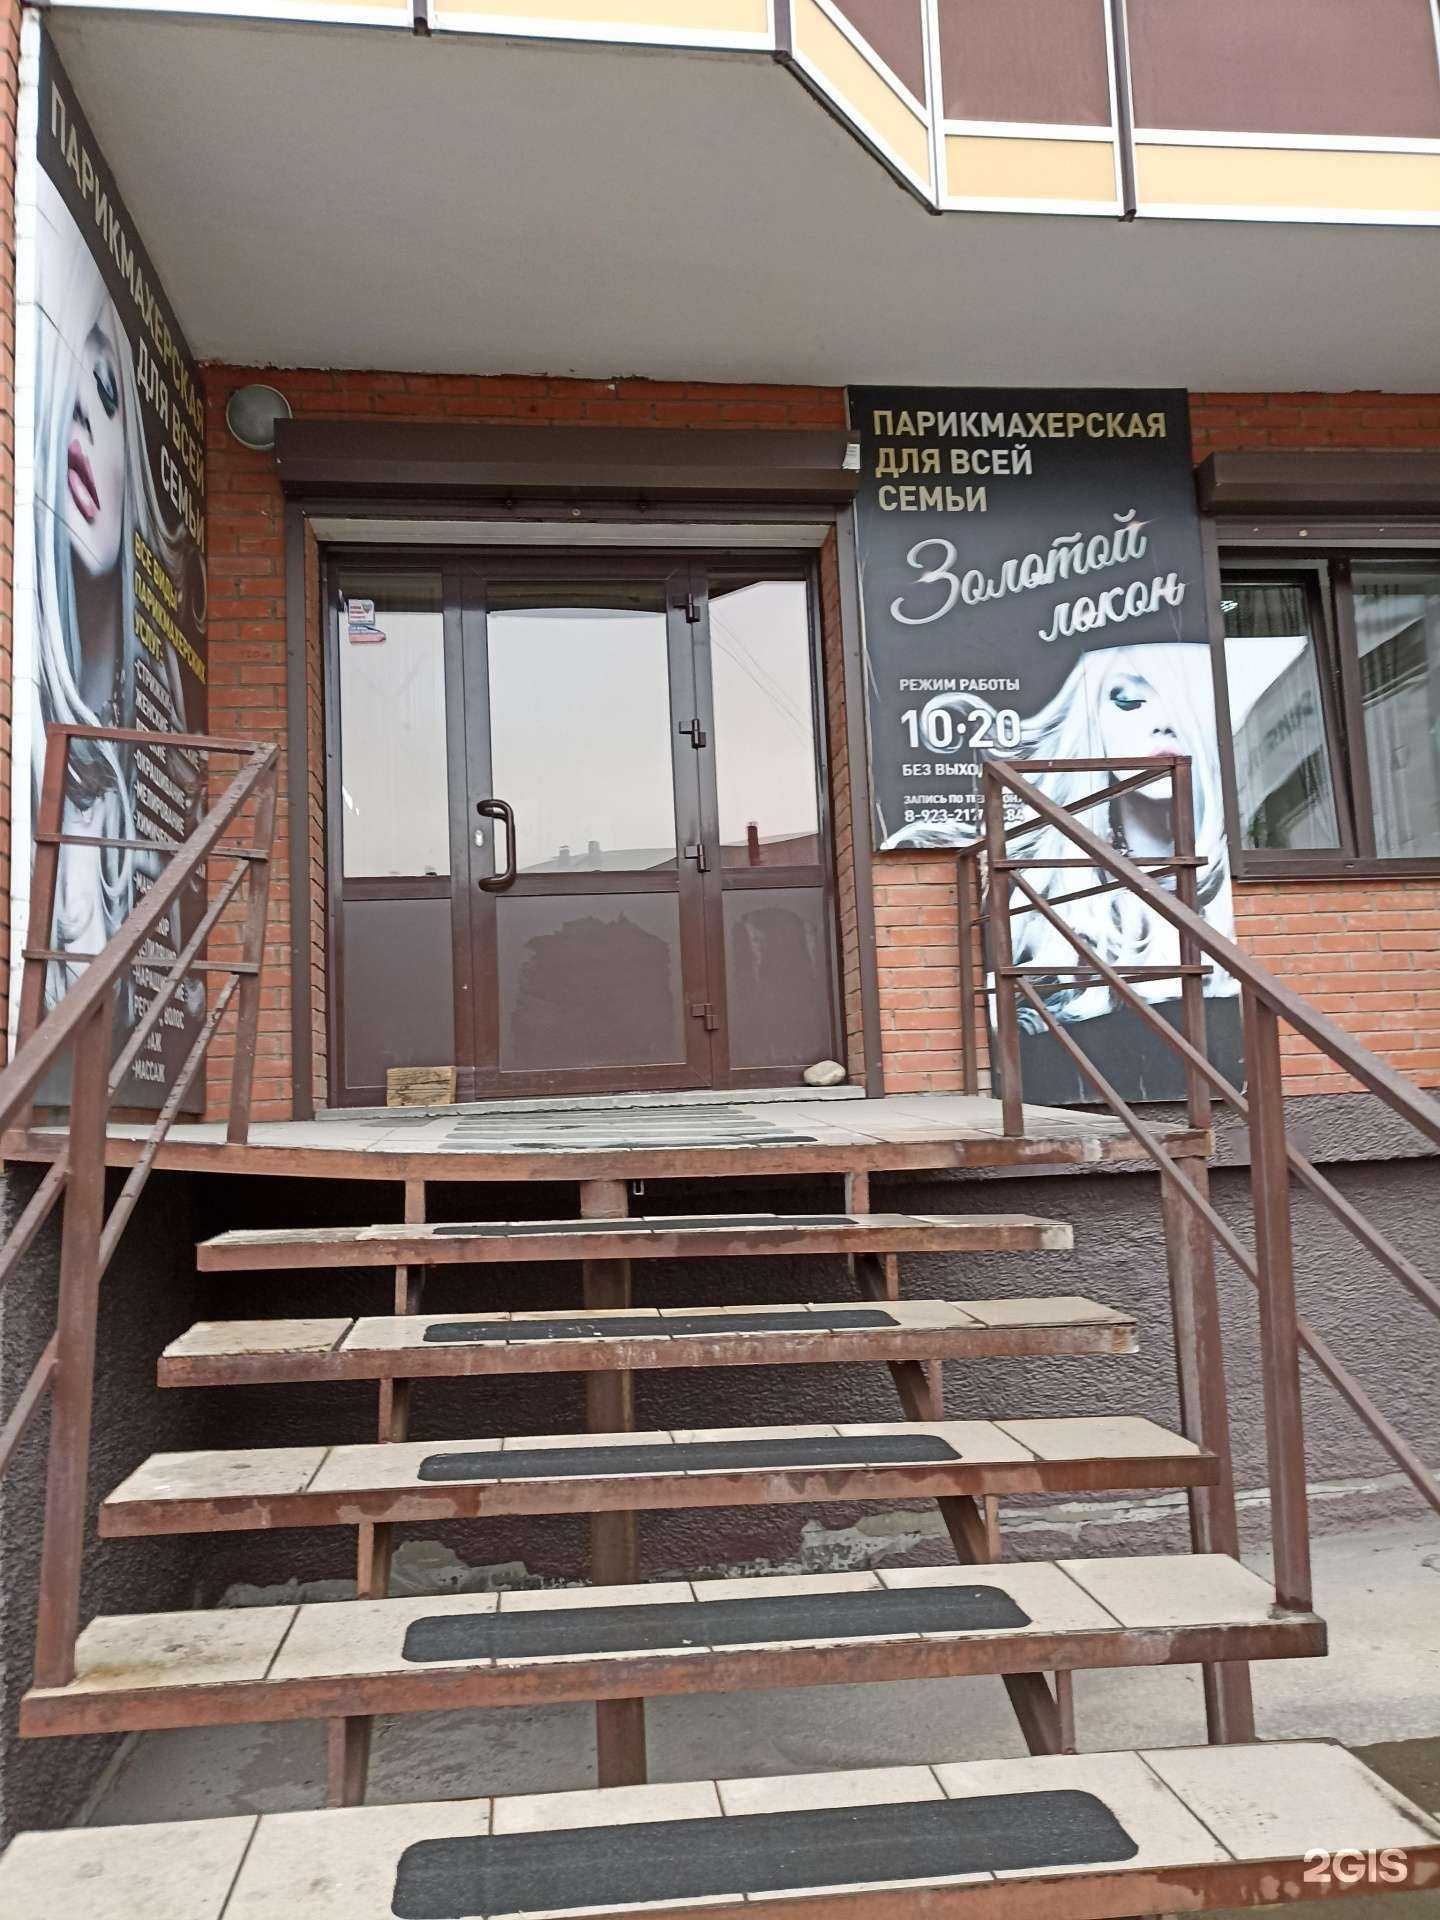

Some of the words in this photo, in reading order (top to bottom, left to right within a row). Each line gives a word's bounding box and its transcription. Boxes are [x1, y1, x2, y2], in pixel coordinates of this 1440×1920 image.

[51, 80, 205, 440] ПАРИКМАХЕРСКАЯ
[137, 336, 169, 430] ДЛЯ
[172, 402, 205, 497] ВСЕЙ
[873, 410, 1167, 438] ПАРИКМАХЕРСКАЯ
[875, 447, 941, 478] ДЛЯ
[950, 443, 1033, 475] ВСЕЙ
[161, 444, 205, 553] СЕМЬИ
[878, 485, 988, 512] СЕМЬИ
[890, 508, 1149, 625] Золотой
[1038, 572, 1187, 641] локон
[899, 678, 956, 691] РЕЖИМ
[959, 678, 1020, 691] РАБОТЫ
[902, 764, 932, 776] БЕЗ
[903, 795, 947, 804] ЗАПИСЬ
[948, 795, 964, 804] ПО
